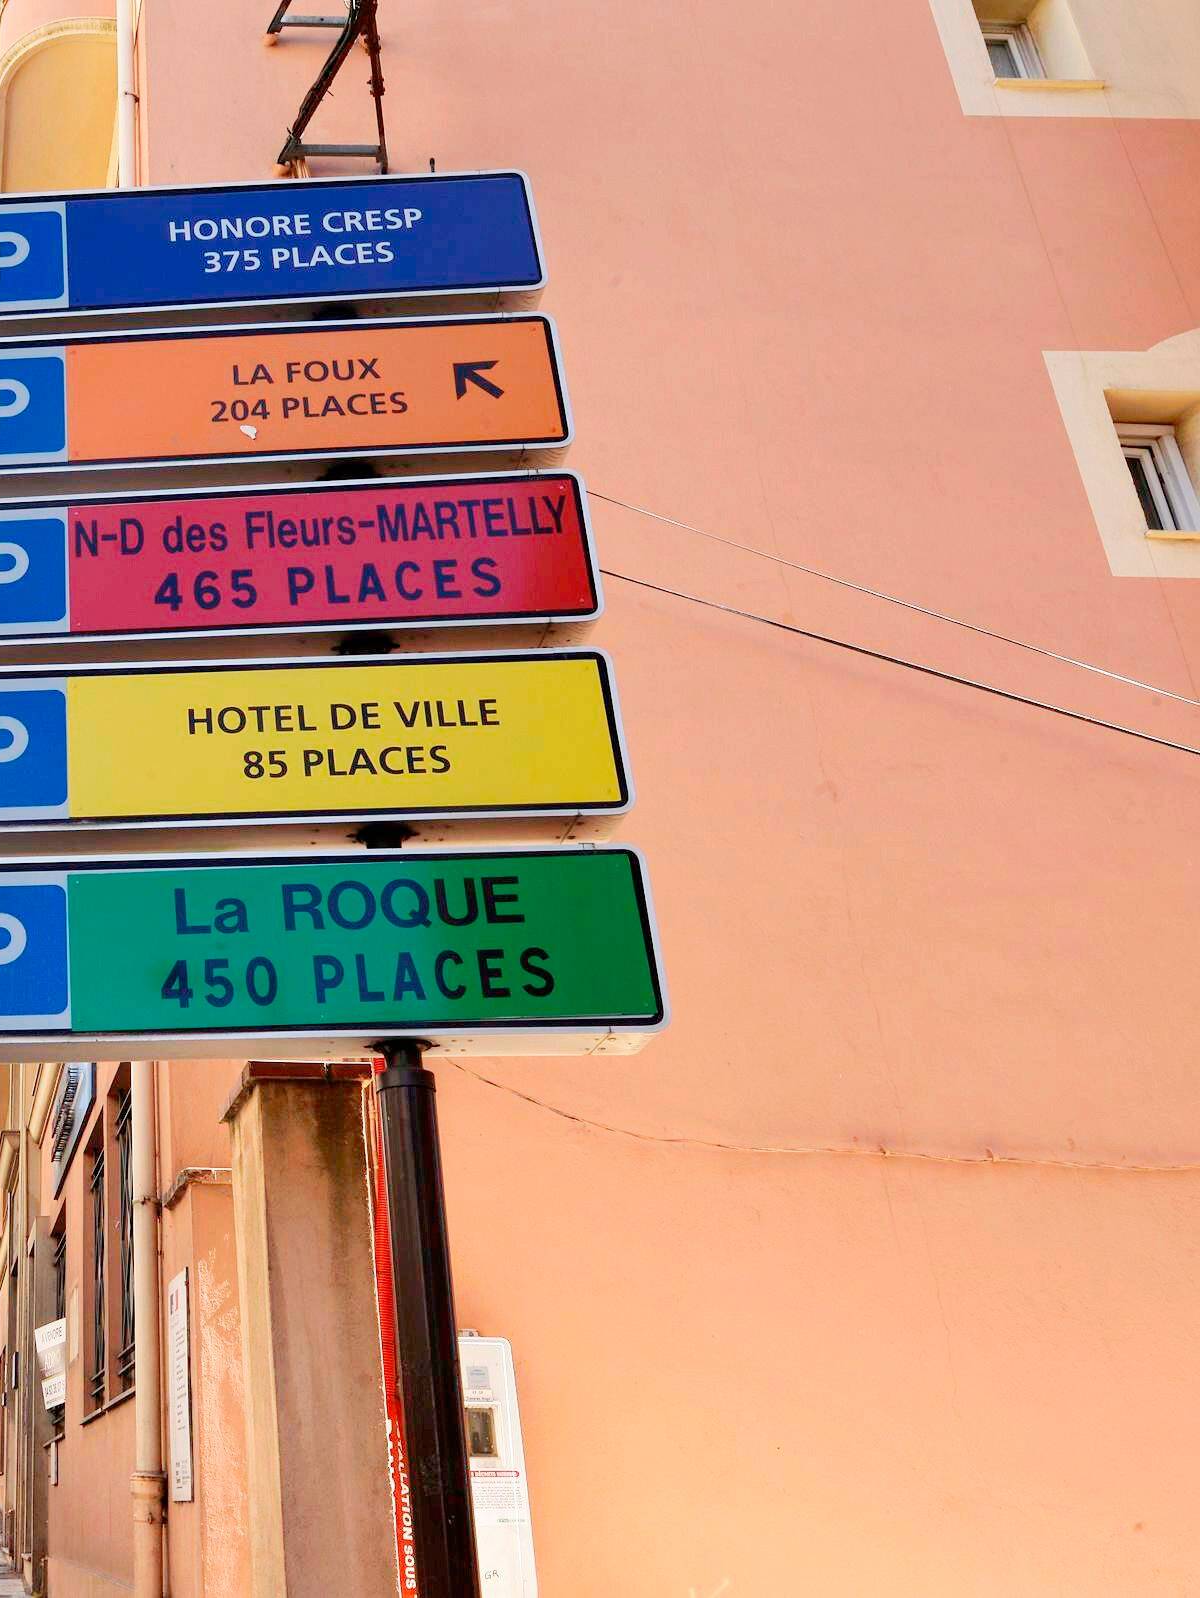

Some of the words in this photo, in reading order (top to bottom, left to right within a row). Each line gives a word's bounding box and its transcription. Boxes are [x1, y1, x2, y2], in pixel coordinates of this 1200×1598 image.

[169, 214, 312, 242] HONORE
[322, 208, 422, 233] CRESP
[204, 249, 261, 273] 375
[272, 242, 394, 269] PLACES
[232, 363, 275, 386] LA
[286, 358, 382, 384] FOUX
[210, 398, 271, 423] 204
[281, 391, 408, 419] PLACES
[74, 517, 145, 558] N-D
[163, 514, 229, 554] des
[245, 495, 568, 550] Fleurs-MARTELLY
[154, 568, 258, 612] 465
[287, 556, 502, 606] PLACES
[187, 704, 318, 735] HOTEL
[330, 702, 381, 731] DE
[393, 698, 500, 728] VILLE
[243, 750, 288, 779] 85
[303, 745, 451, 777] PLACES
[174, 887, 250, 936] La
[282, 876, 526, 932] ROQUE
[158, 957, 279, 1009] 450
[313, 947, 556, 1005] PLACES
[403, 1544, 417, 1590] SOUS
